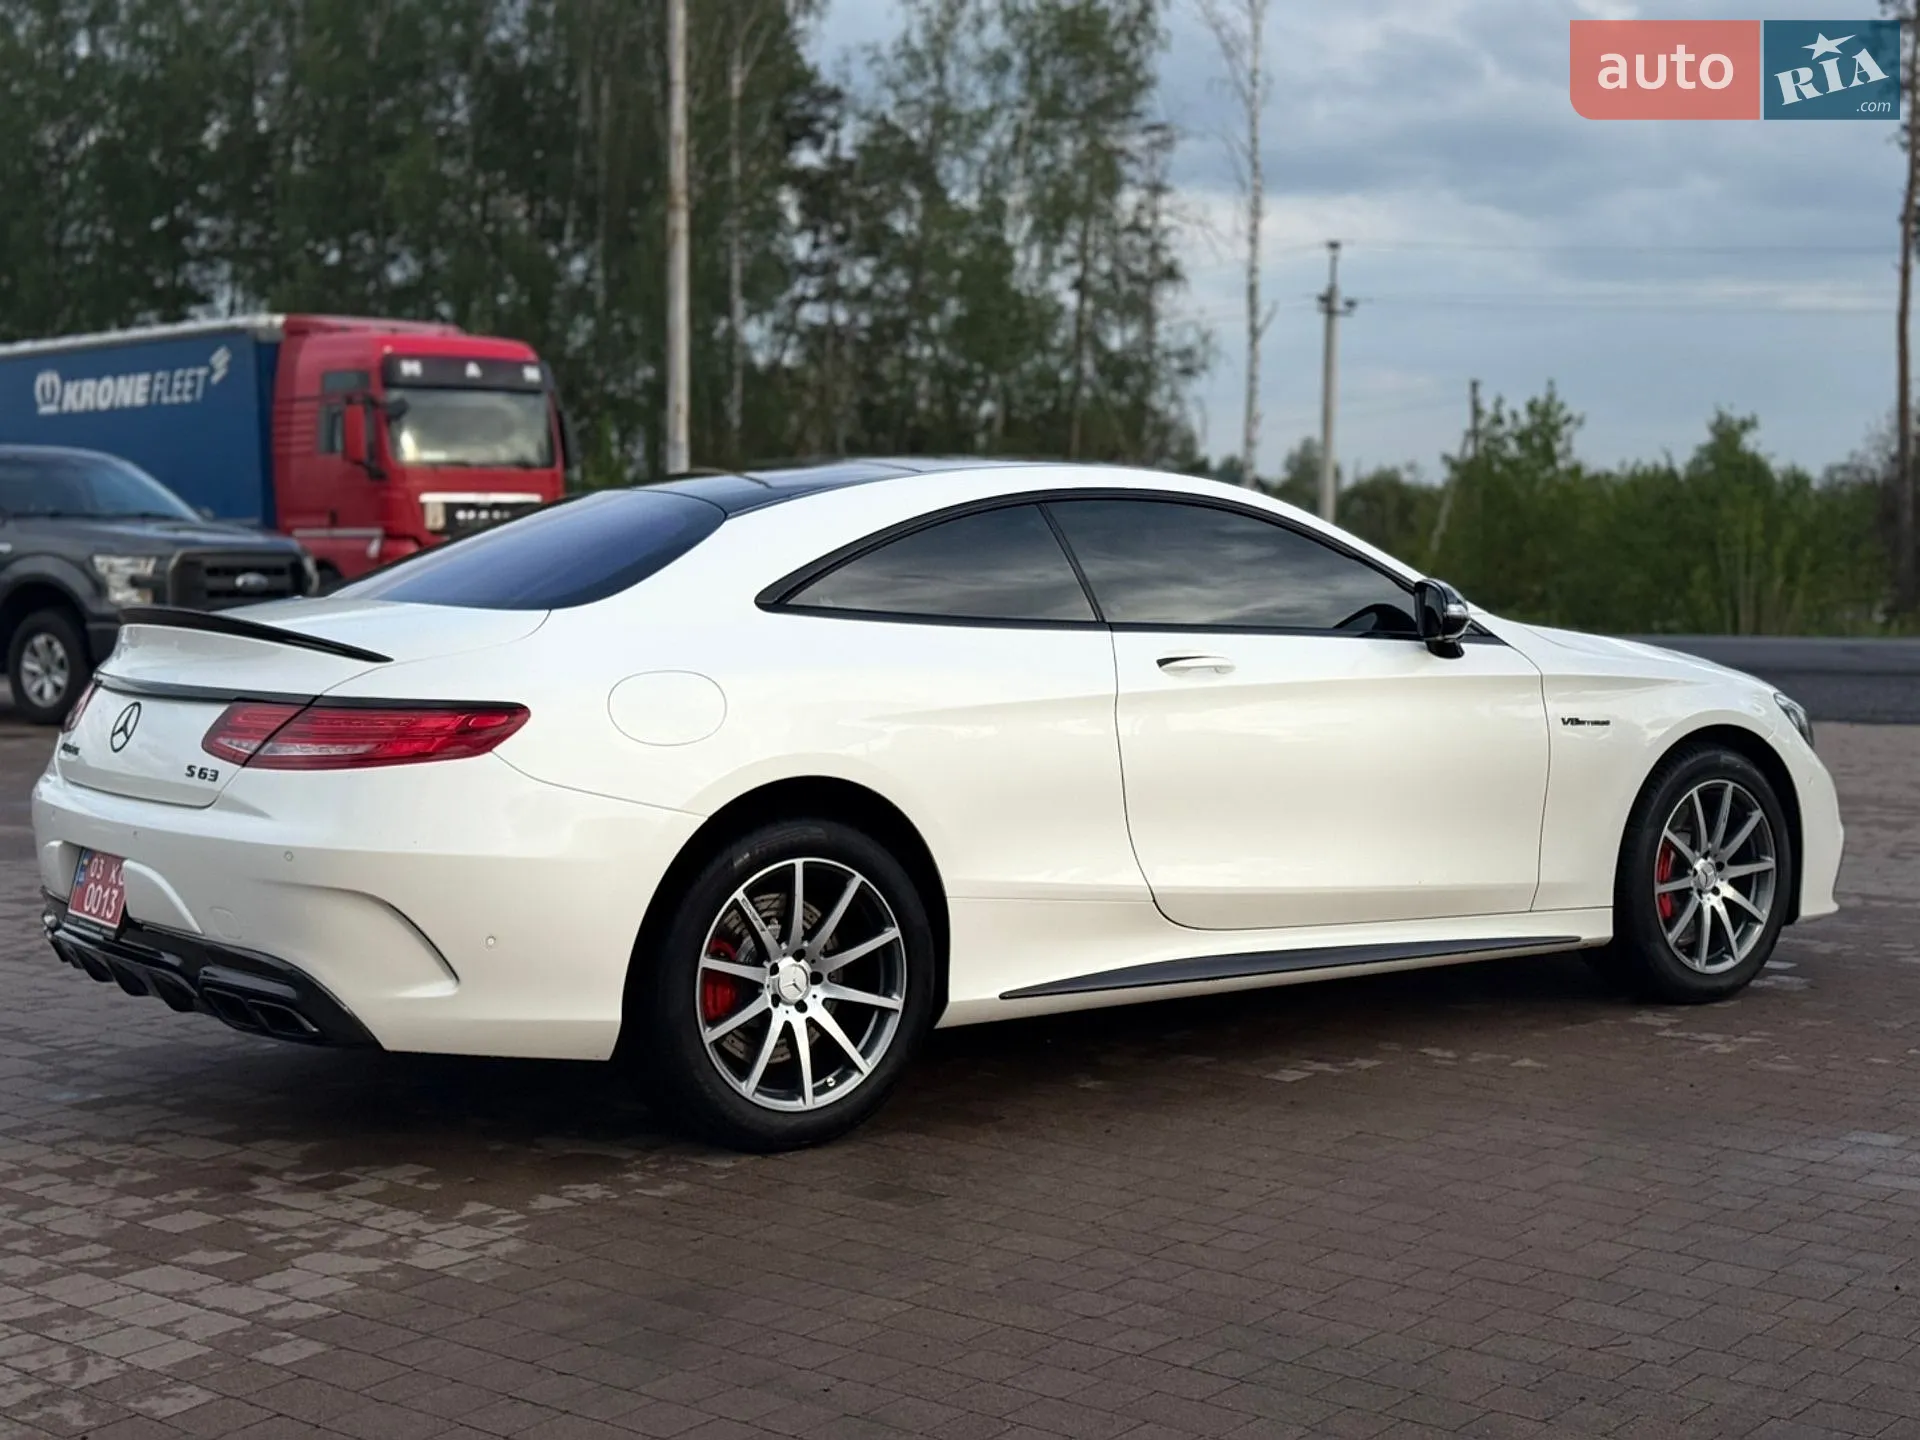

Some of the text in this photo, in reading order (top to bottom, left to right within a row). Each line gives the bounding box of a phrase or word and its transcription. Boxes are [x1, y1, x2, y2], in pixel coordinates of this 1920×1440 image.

[61, 365, 209, 413] KRONE FLEET
[185, 765, 219, 782] S 63
[84, 883, 118, 919] 0013
